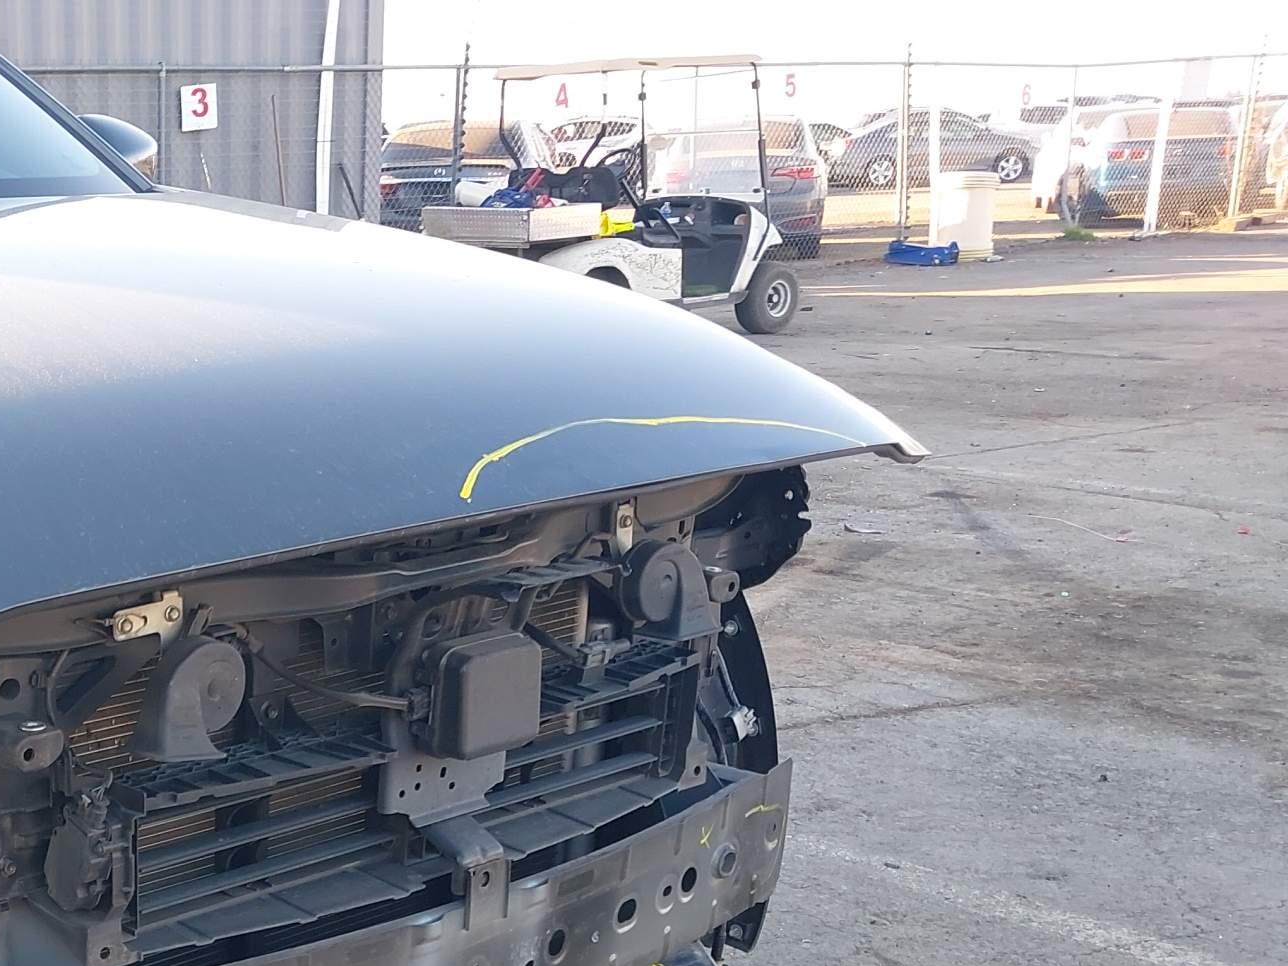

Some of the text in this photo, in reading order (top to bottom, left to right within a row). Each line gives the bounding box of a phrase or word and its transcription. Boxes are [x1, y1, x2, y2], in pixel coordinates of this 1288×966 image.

[555, 83, 569, 108] 4
[785, 74, 796, 97] 5
[1022, 84, 1031, 105] 6
[191, 88, 209, 117] 3
